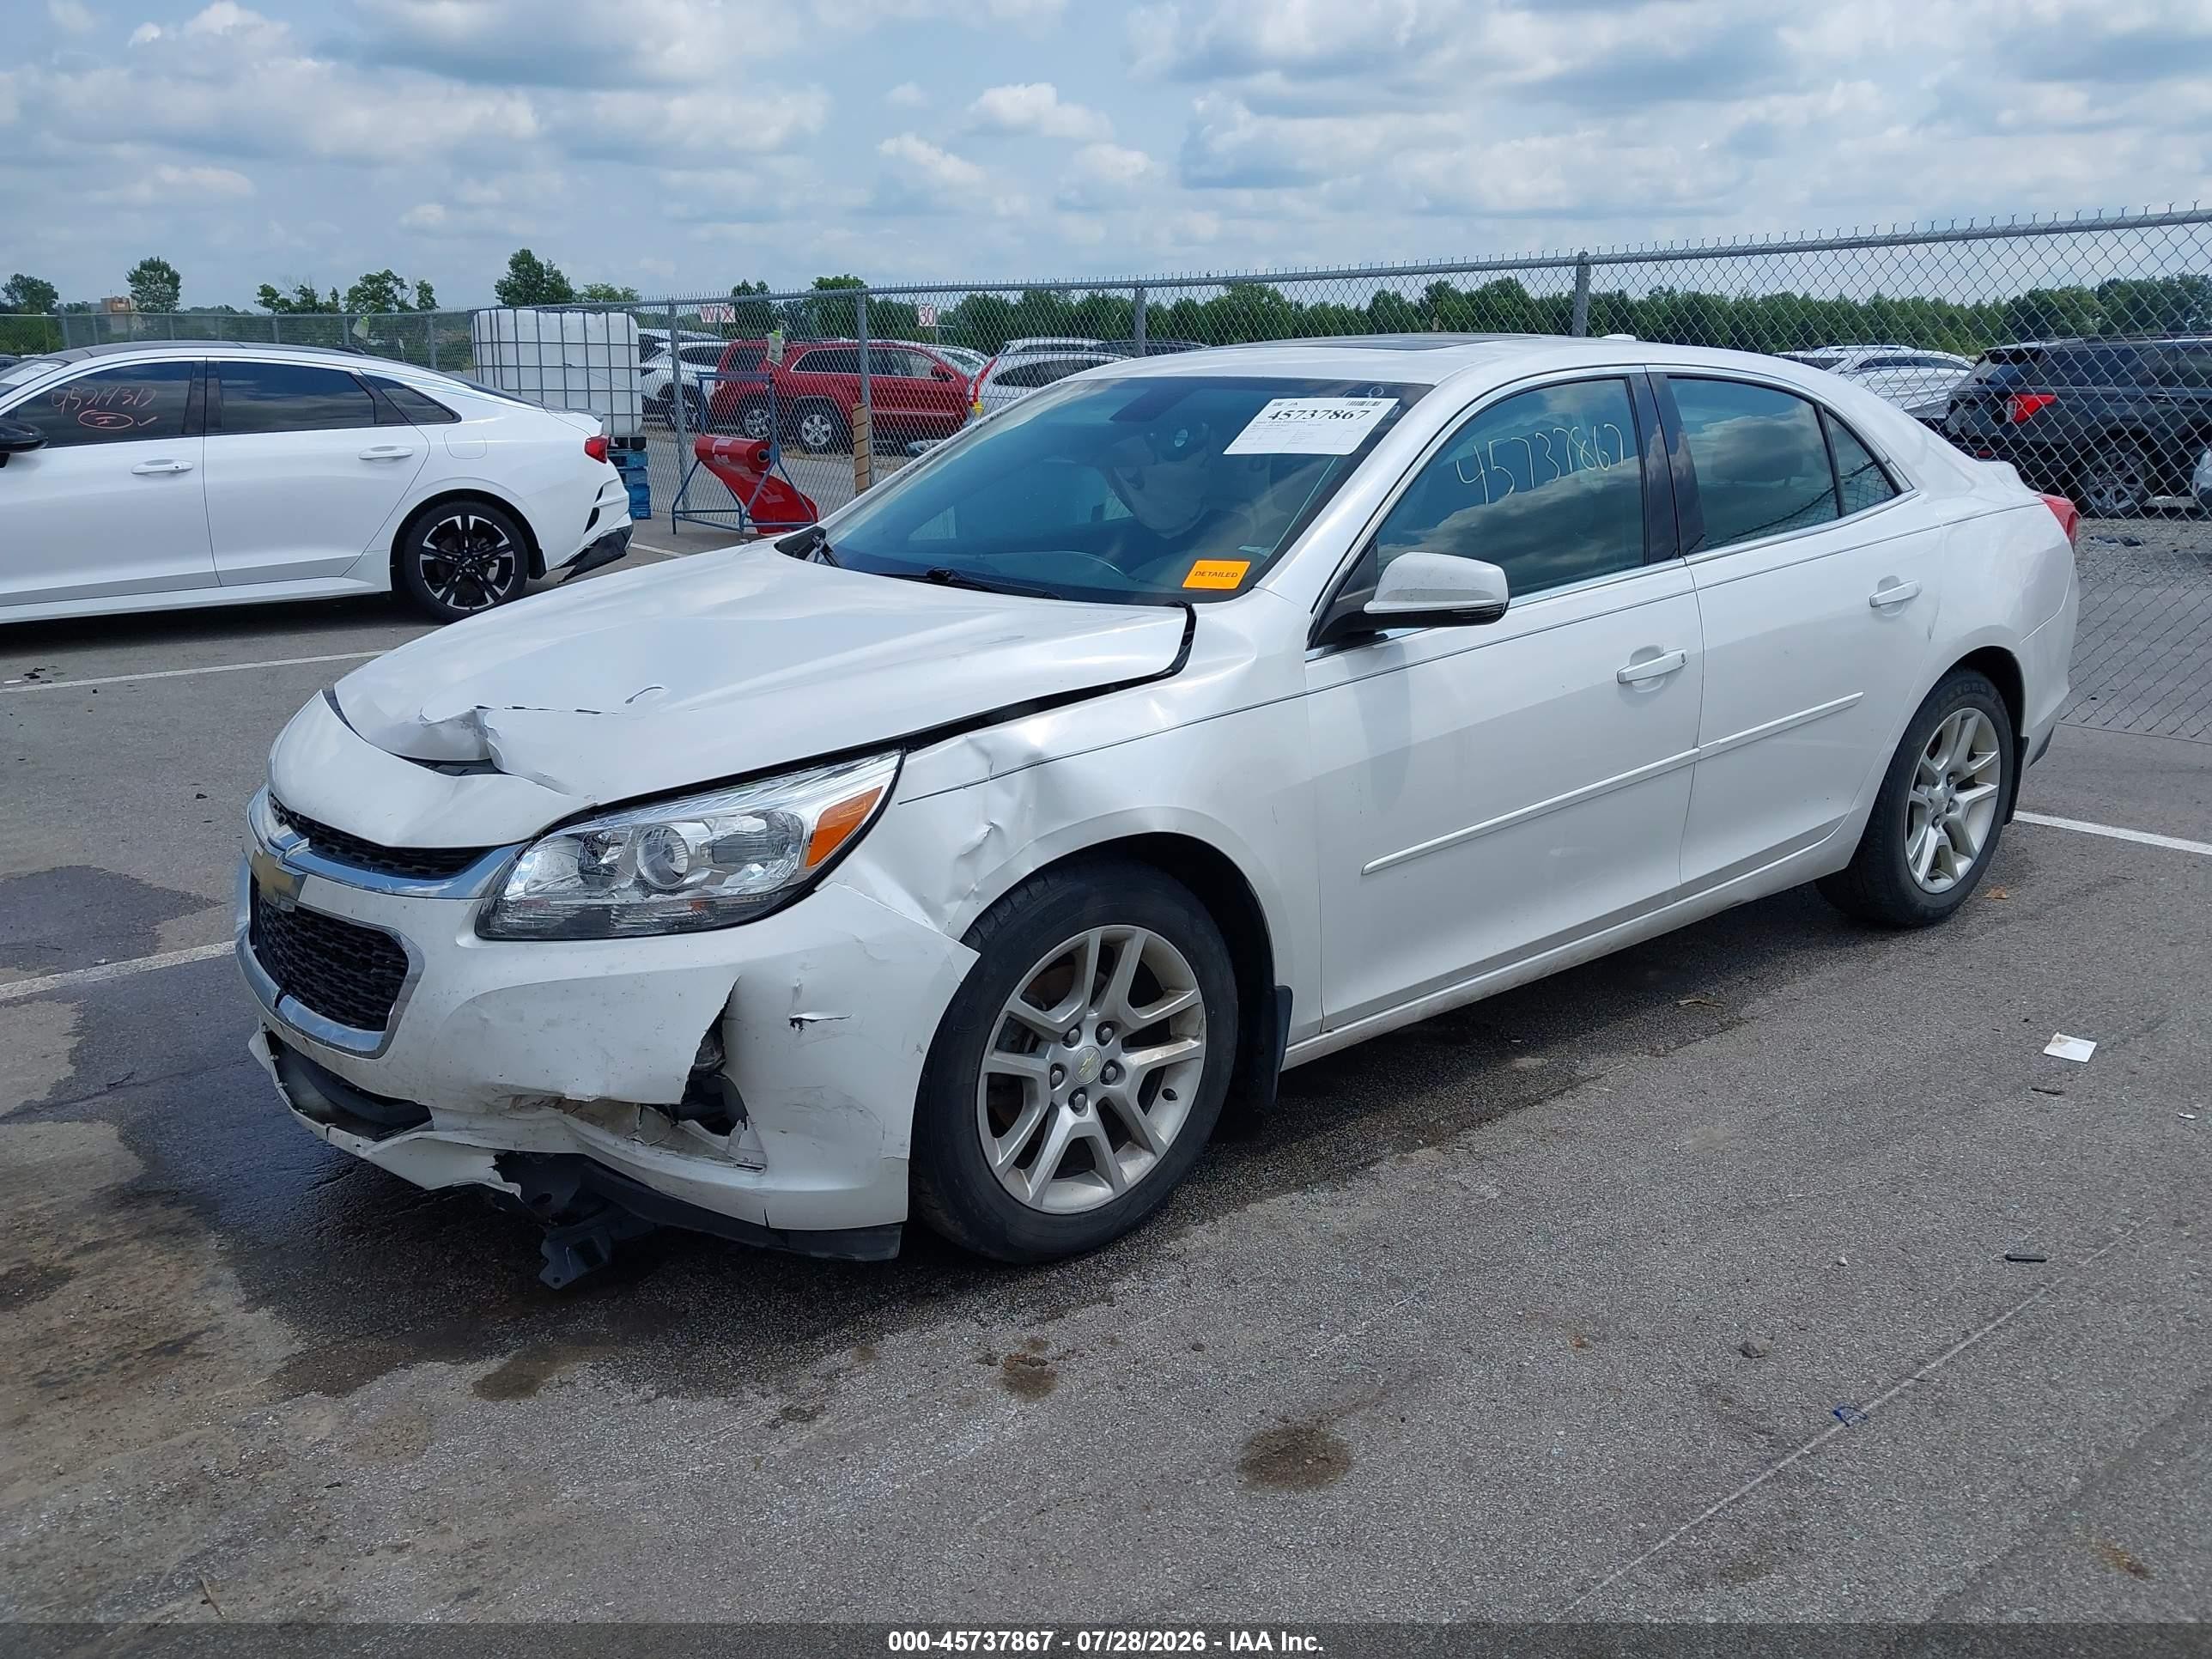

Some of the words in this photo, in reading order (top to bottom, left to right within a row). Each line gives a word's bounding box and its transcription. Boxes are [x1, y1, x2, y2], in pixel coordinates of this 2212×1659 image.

[701, 307, 716, 322] W
[721, 307, 734, 322] X
[920, 307, 935, 325] 30
[1267, 409, 1372, 420] 45737867
[1455, 423, 1626, 507] 45737867
